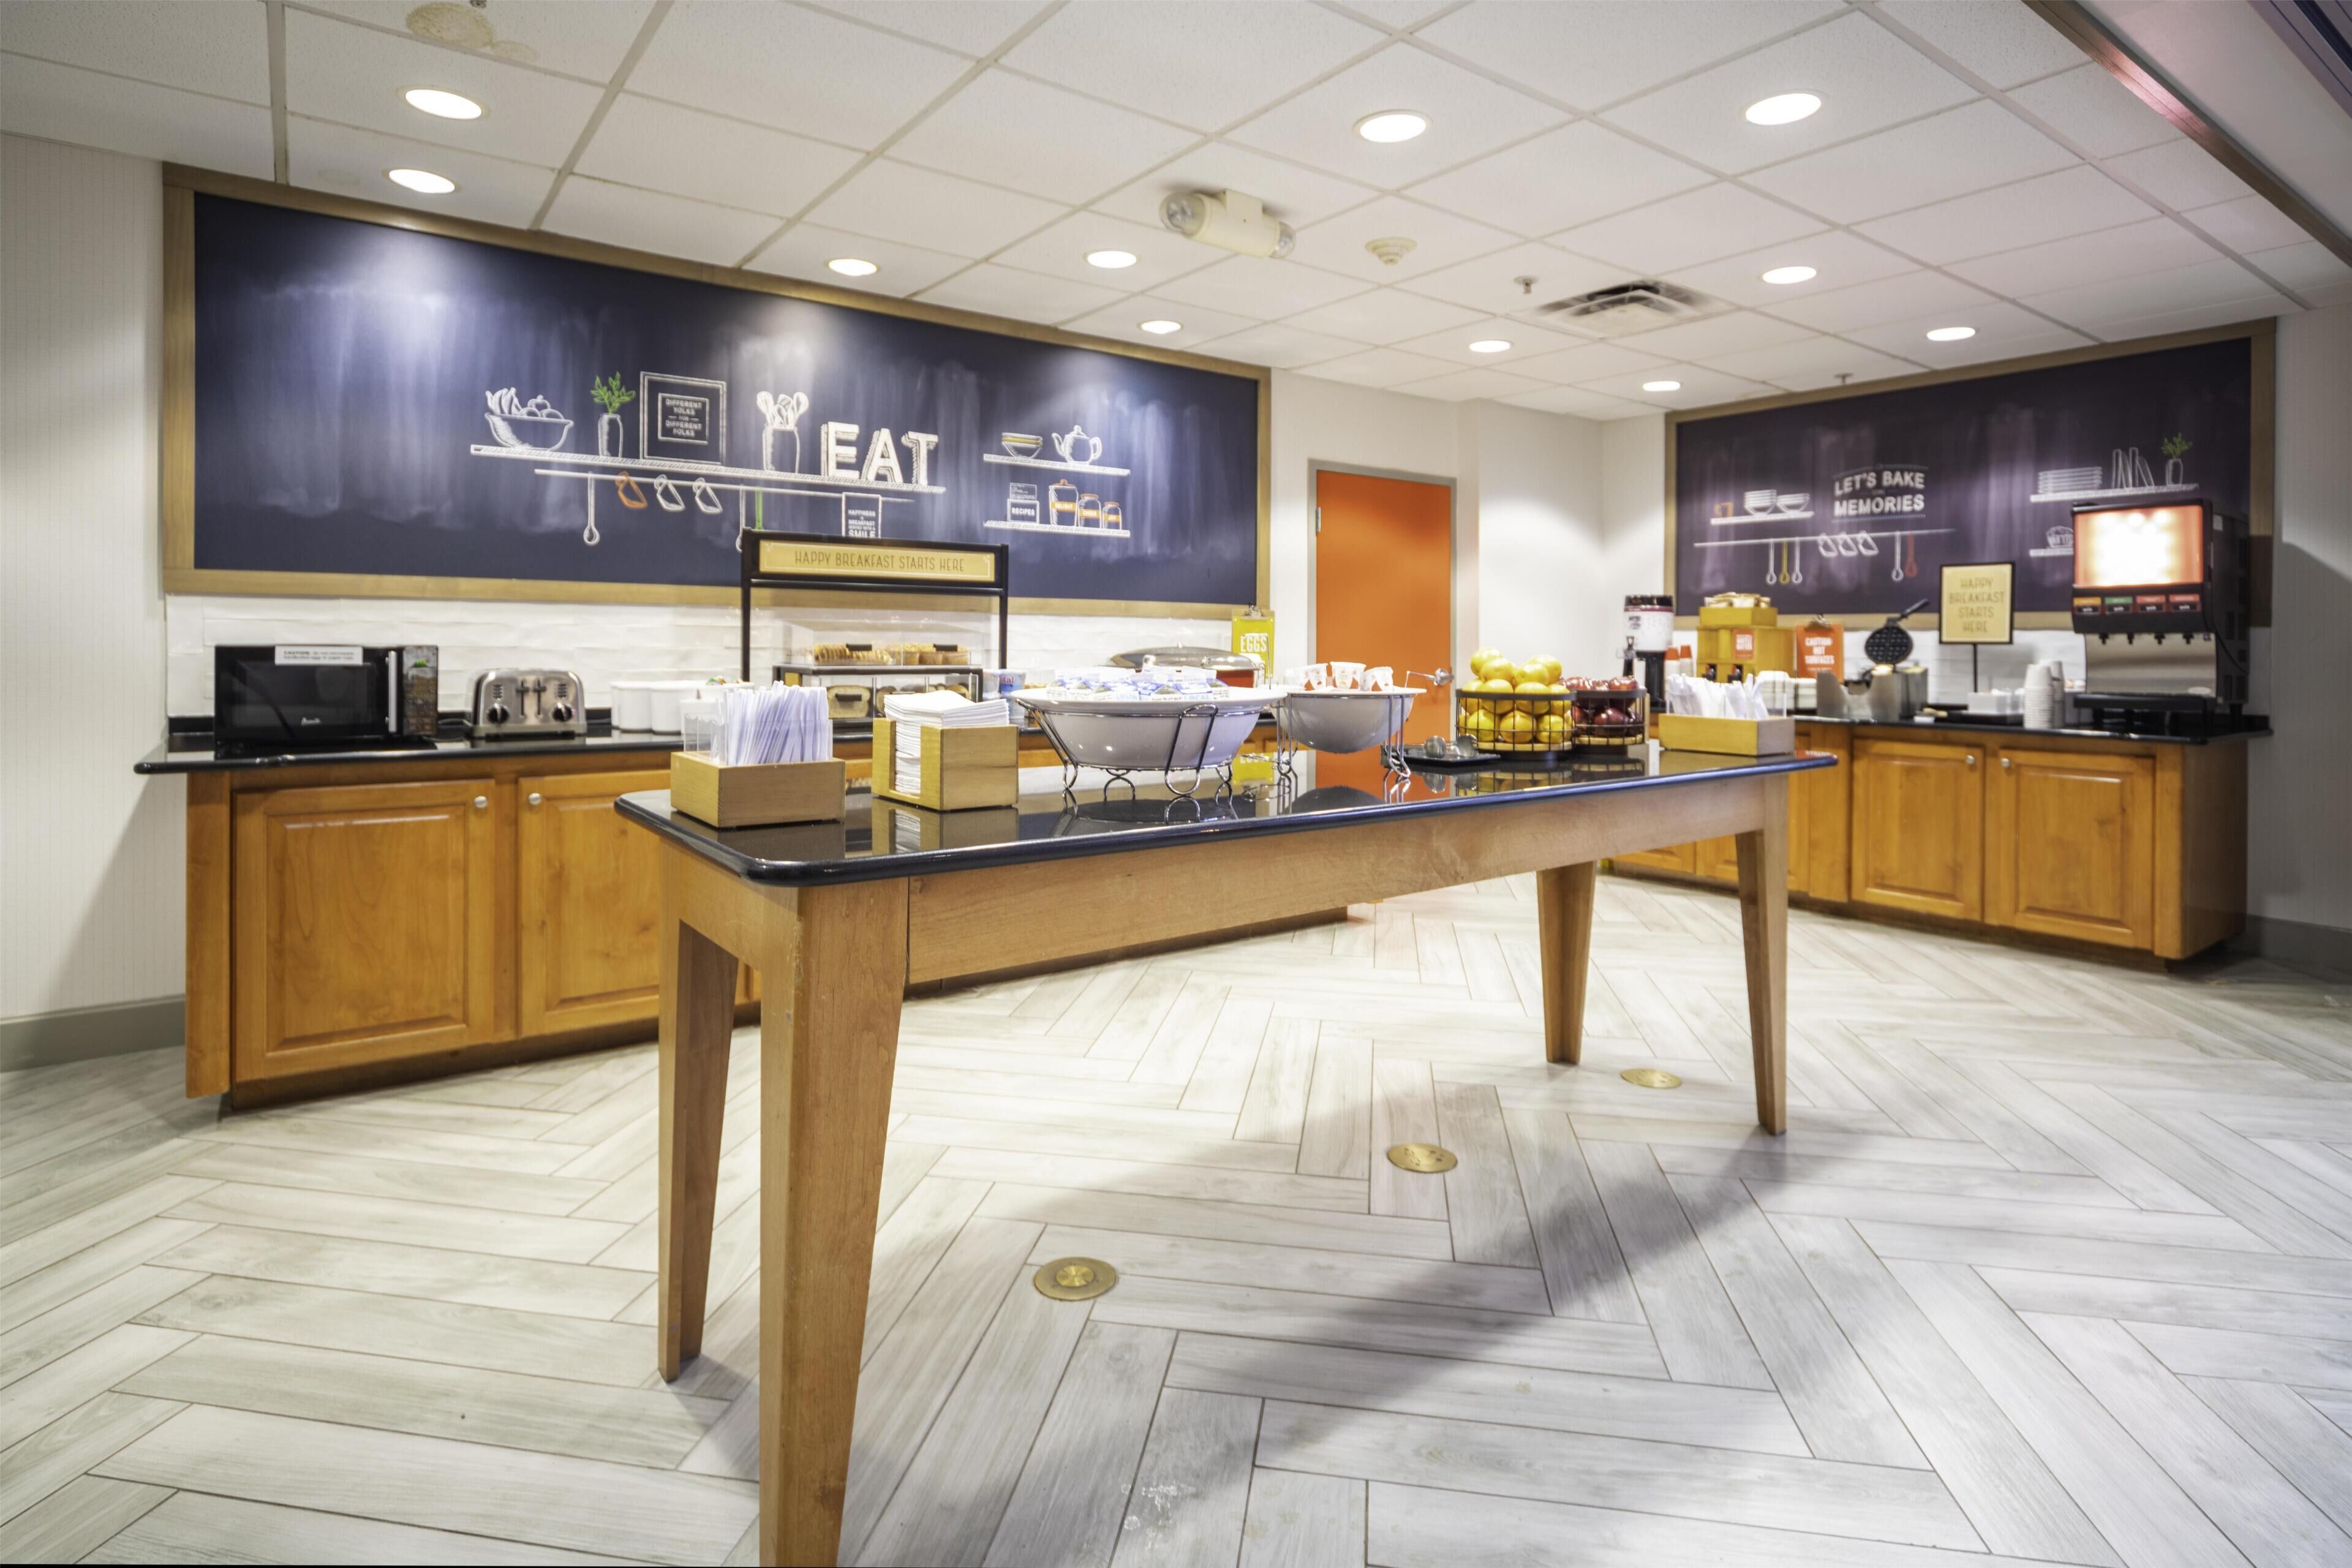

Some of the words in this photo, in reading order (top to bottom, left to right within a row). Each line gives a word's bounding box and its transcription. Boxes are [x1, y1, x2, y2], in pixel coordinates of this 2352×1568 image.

[666, 398, 702, 409] DIFFERENT
[673, 407, 695, 416] YOLKS
[665, 420, 702, 431] DIFFERENT
[673, 428, 695, 437] FOLKS
[821, 421, 938, 486] EAT
[1834, 472, 1877, 497] LET'S
[1882, 470, 1925, 489] BAKE
[1834, 494, 1925, 516] MEMORIES
[1011, 507, 1036, 516] RECIPES
[848, 529, 876, 538] SMILE
[795, 550, 831, 565] HAPPY
[835, 552, 895, 569] BREAKFAST
[899, 556, 935, 570] STARTS
[940, 557, 964, 571] HERE
[1960, 577, 1993, 589] HAPPY
[1950, 592, 2004, 605] BREAKFAST
[1959, 606, 1994, 619] STARTS
[1962, 621, 1989, 633] HERE
[1240, 635, 1267, 653] EGGS
[1813, 646, 1825, 655] HOT
[1804, 655, 1835, 665] SURFACES
